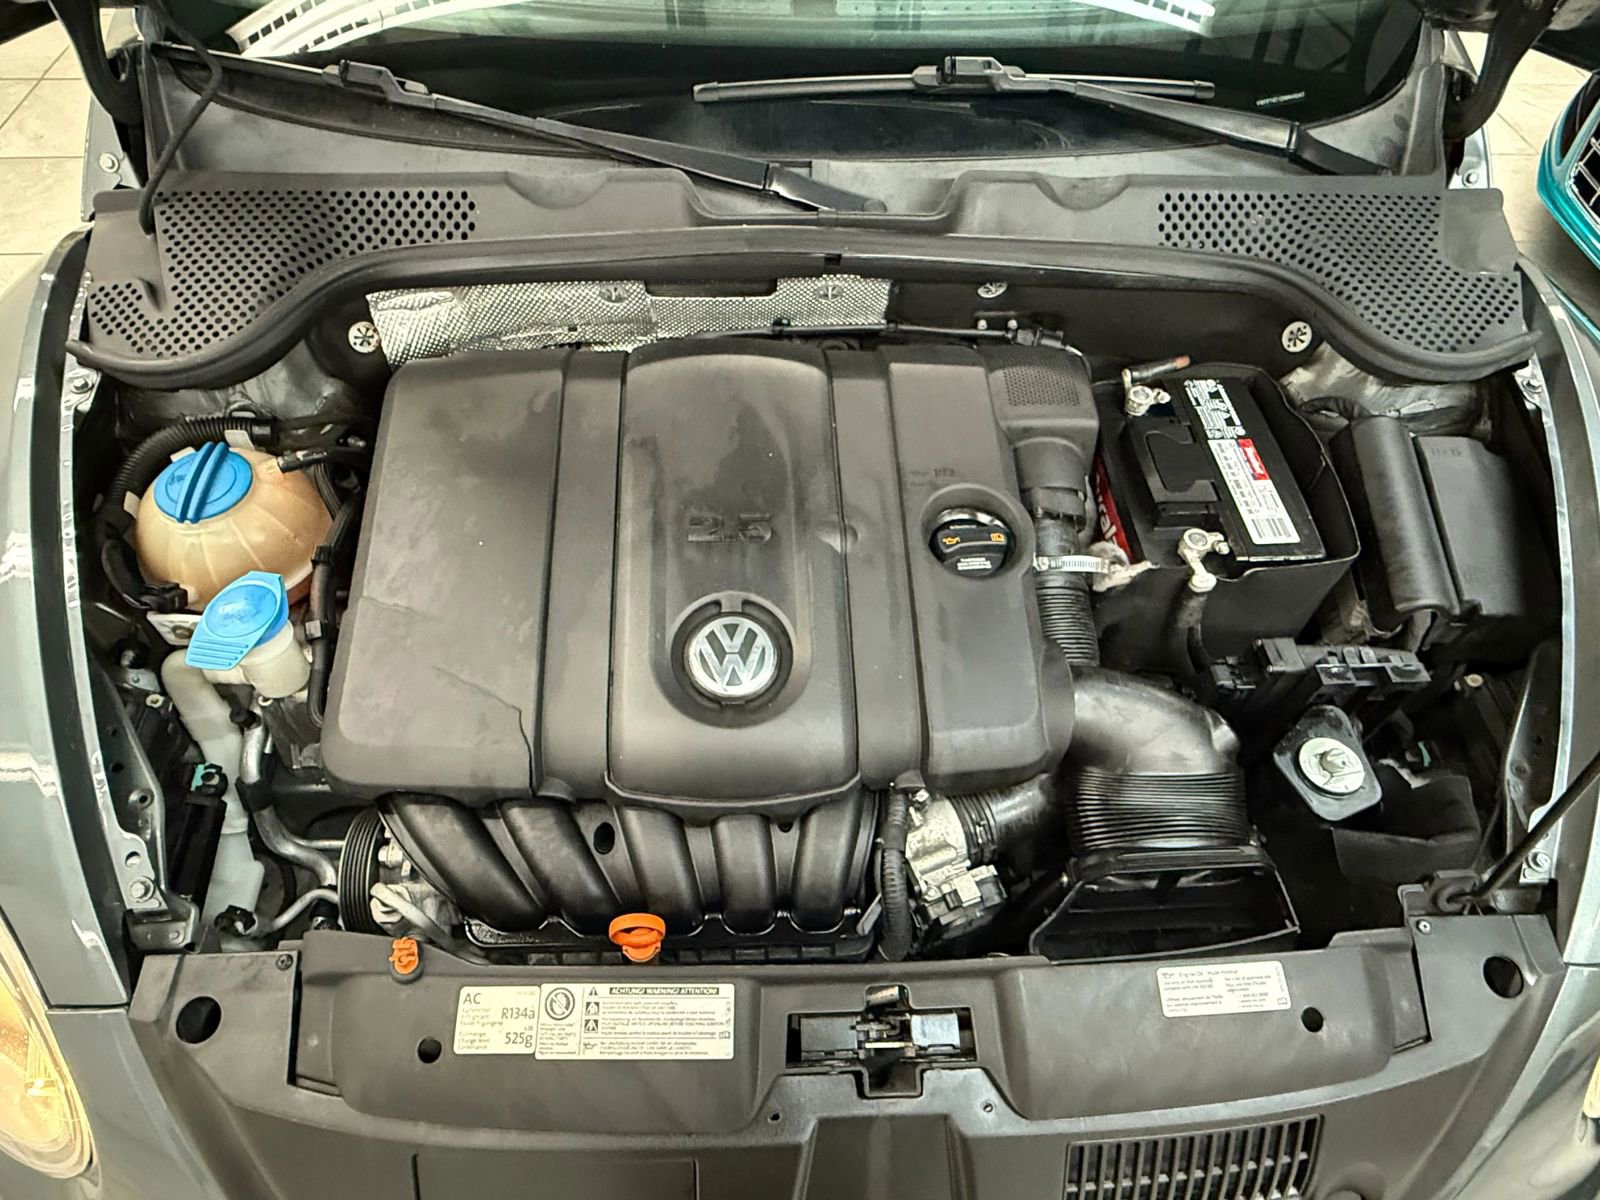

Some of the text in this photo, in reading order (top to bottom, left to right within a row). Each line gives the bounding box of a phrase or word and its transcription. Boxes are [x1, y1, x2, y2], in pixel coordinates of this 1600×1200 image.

[690, 616, 777, 697] VW
[463, 992, 482, 1005] AC
[501, 1007, 536, 1020] R134a
[504, 1031, 534, 1049] 525g
